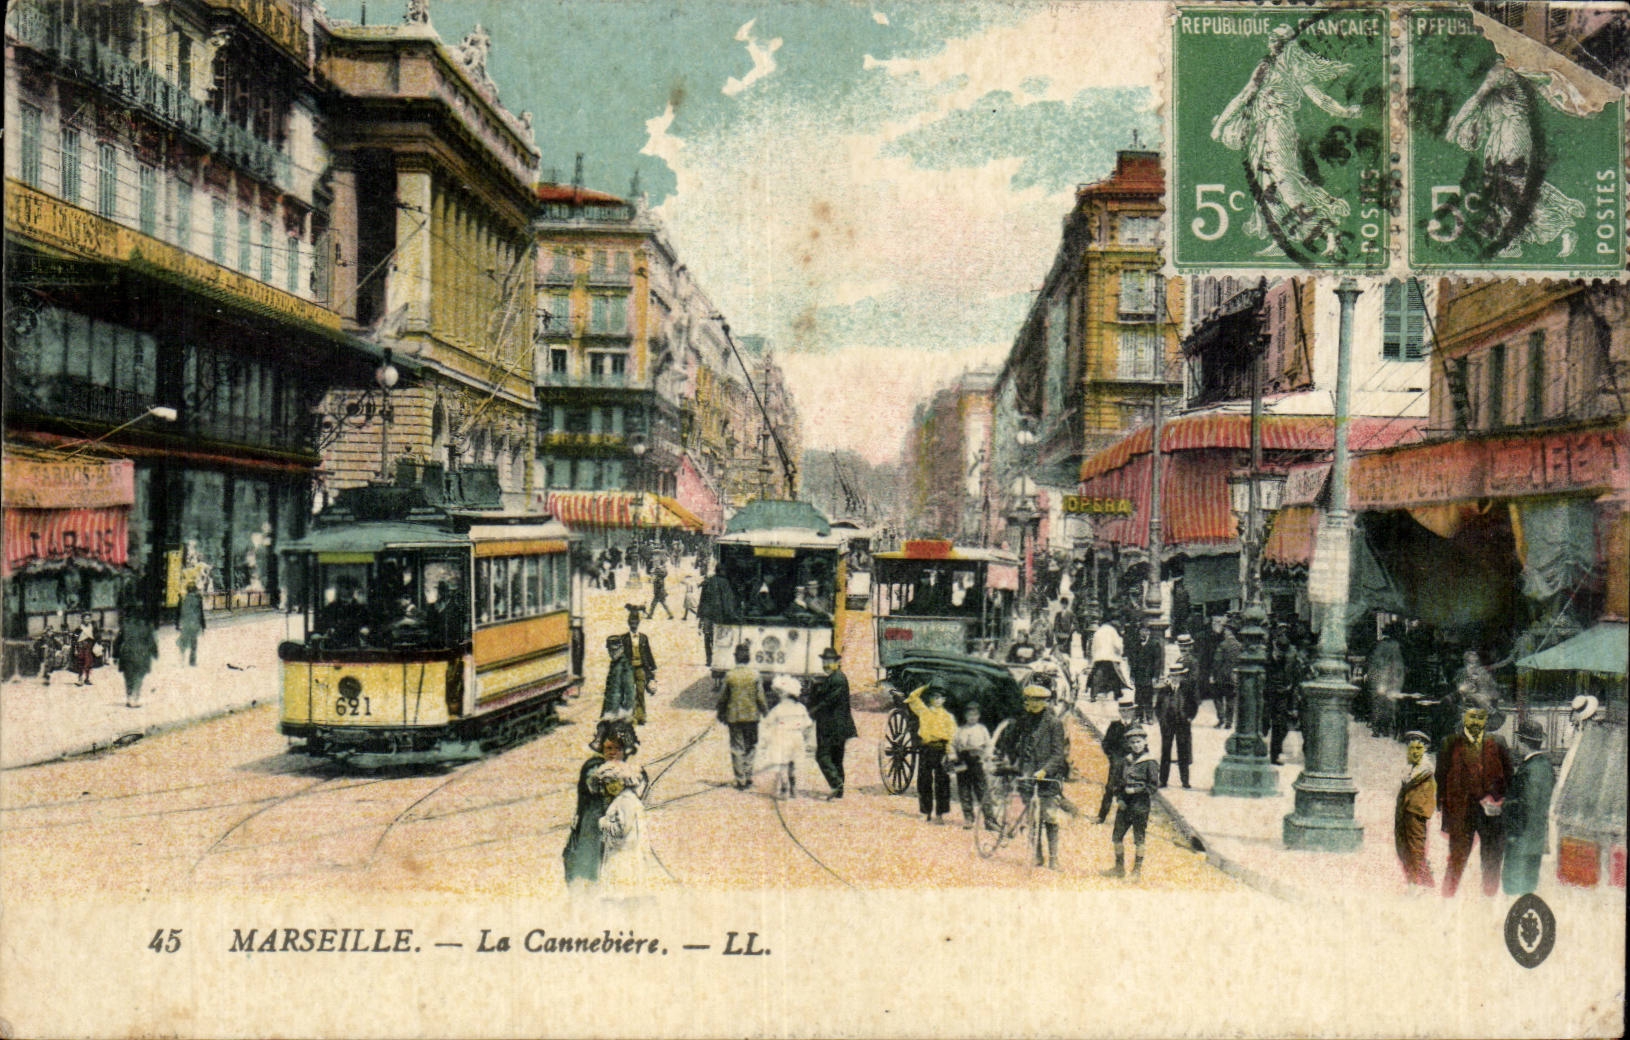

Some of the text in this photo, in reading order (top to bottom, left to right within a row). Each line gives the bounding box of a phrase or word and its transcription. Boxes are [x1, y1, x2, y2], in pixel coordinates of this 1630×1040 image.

[1181, 16, 1271, 37] REPUBLIQUE
[1596, 168, 1616, 254] POSTES
[755, 650, 786, 665] 638
[335, 695, 372, 717] 621
